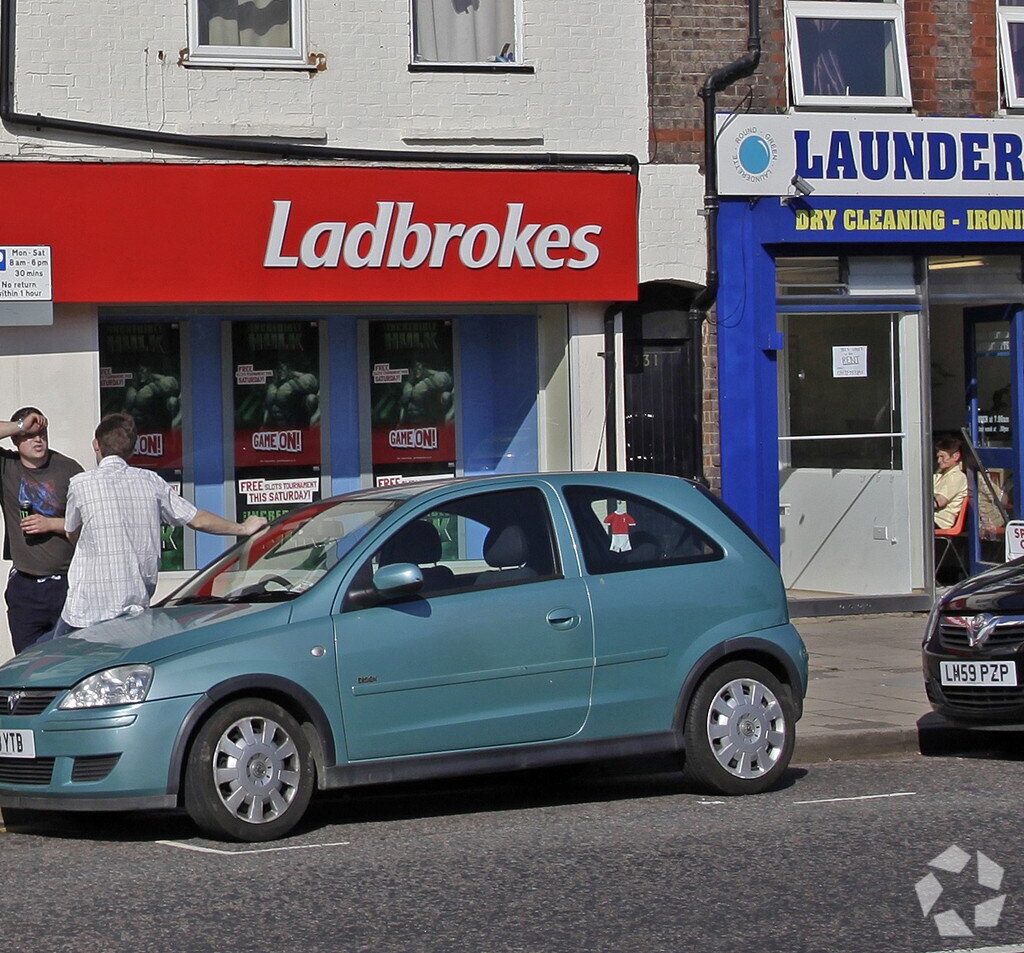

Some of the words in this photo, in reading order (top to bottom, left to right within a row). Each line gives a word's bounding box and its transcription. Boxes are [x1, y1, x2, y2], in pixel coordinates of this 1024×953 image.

[735, 127, 757, 144] ROUND
[765, 134, 778, 161] GREEN
[794, 130, 1024, 181] LAUNDER
[795, 209, 837, 231] DRY
[843, 209, 945, 231] CLEANING
[967, 210, 1024, 231] IRONI
[263, 200, 602, 269] Ladbrokes
[12, 249, 27, 257] Mon
[33, 249, 45, 257] Sat
[139, 434, 162, 454] ON!
[253, 433, 277, 449] GAME
[279, 431, 300, 450] ON!
[390, 430, 413, 447] GAME
[415, 428, 436, 447] ON!
[240, 480, 263, 492] FREE
[283, 481, 317, 490] TOURNAMENT
[249, 493, 267, 503] THIS
[269, 490, 311, 502] SATURDAY!
[945, 664, 976, 682] LH59
[980, 663, 1009, 682] PZP
[2, 732, 23, 753] YTB
